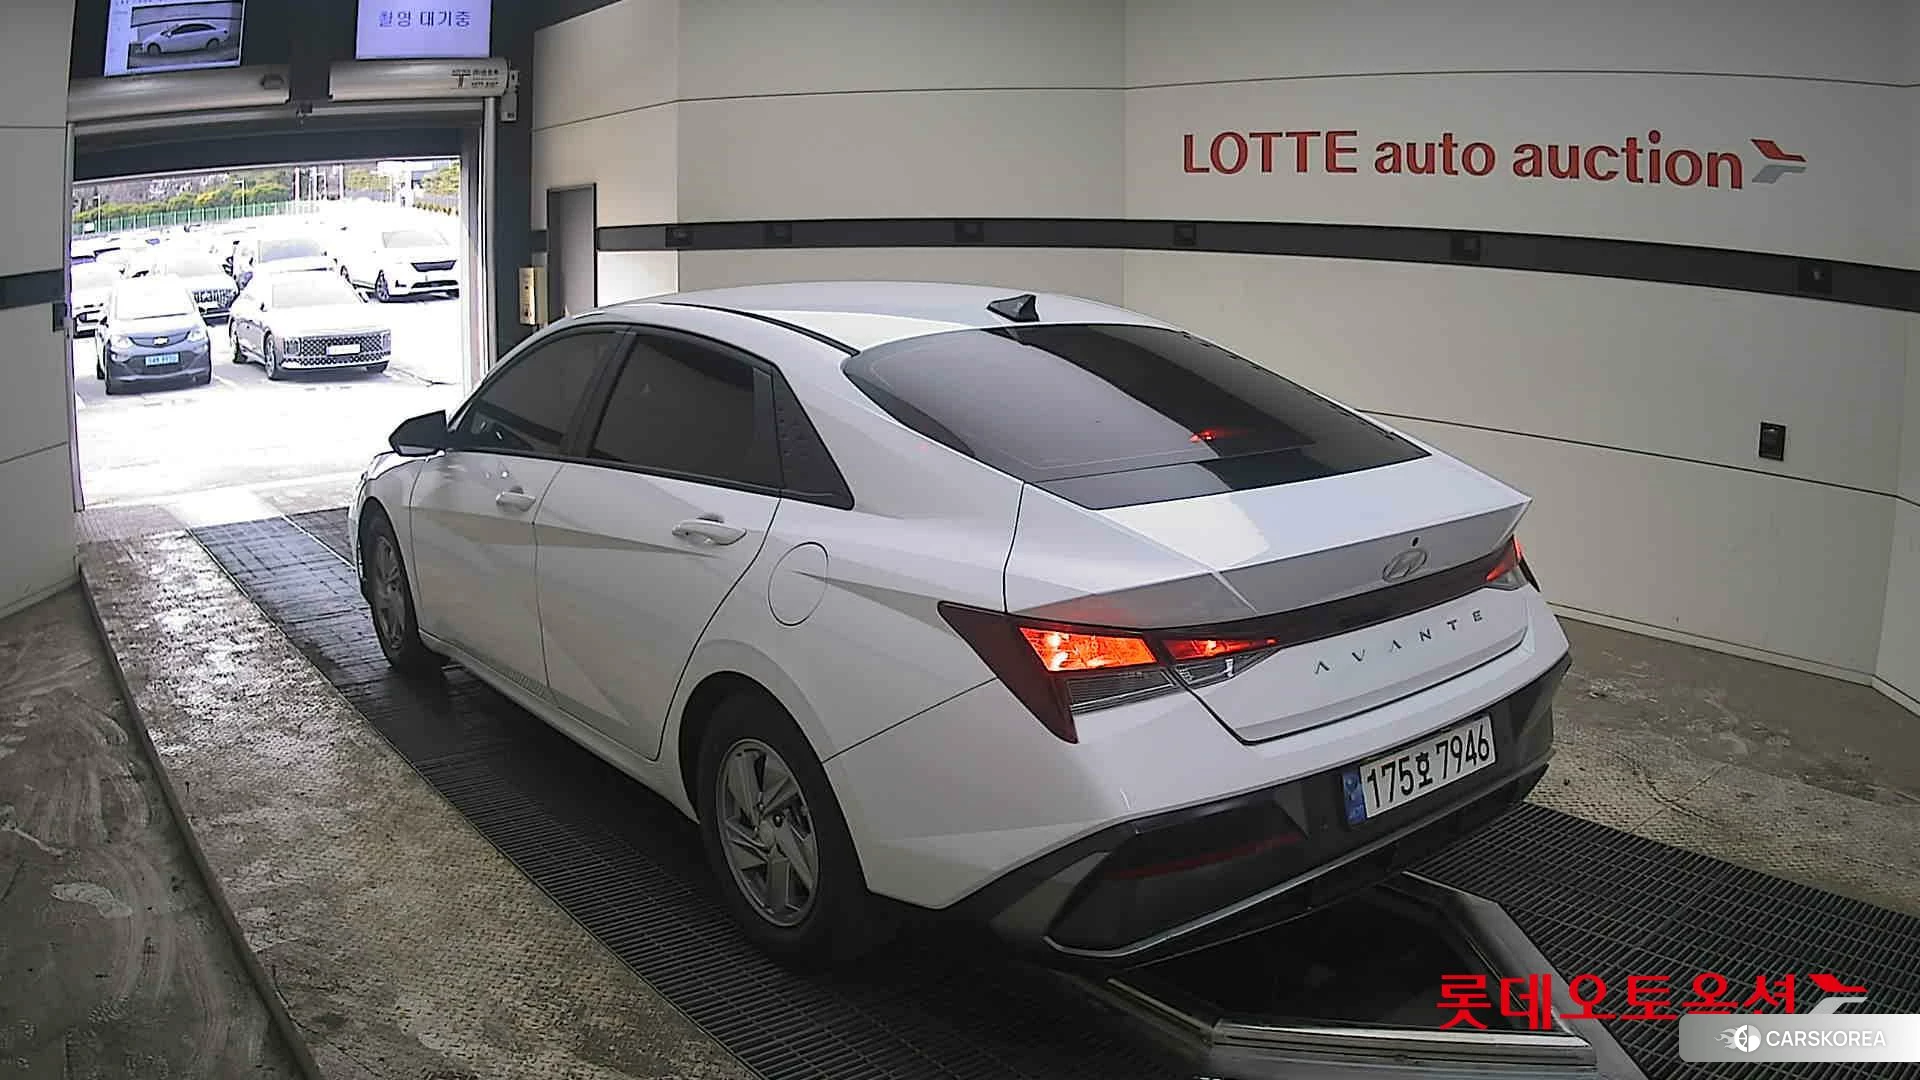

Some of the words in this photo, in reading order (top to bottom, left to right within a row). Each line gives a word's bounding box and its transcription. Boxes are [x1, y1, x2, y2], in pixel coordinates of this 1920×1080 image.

[419, 10, 472, 28] 대기중
[1184, 130, 1359, 174] LOTTE
[1374, 132, 1496, 178] auto
[1512, 130, 1744, 190] auction
[1314, 609, 1483, 675] AVANTE
[1366, 751, 1434, 809] 175호
[1436, 724, 1490, 780] 7946
